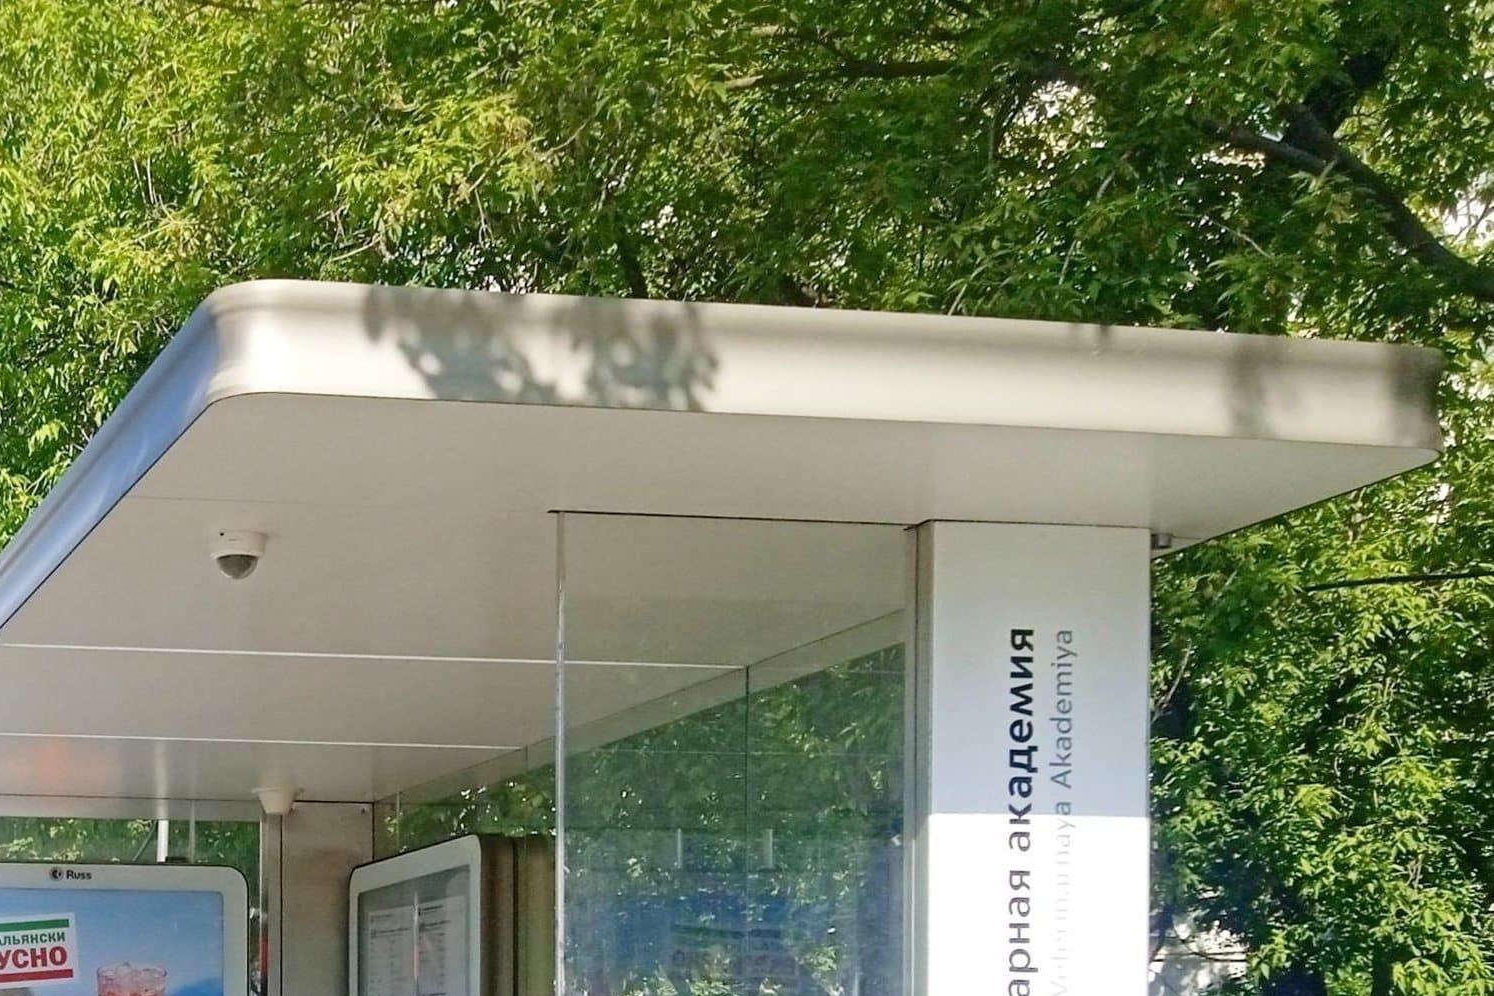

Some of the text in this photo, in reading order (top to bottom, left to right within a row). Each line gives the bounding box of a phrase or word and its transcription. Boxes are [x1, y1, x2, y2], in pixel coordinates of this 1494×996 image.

[1008, 629, 1038, 851] академия
[1049, 629, 1077, 789] Akademiya
[66, 870, 92, 880] Russ
